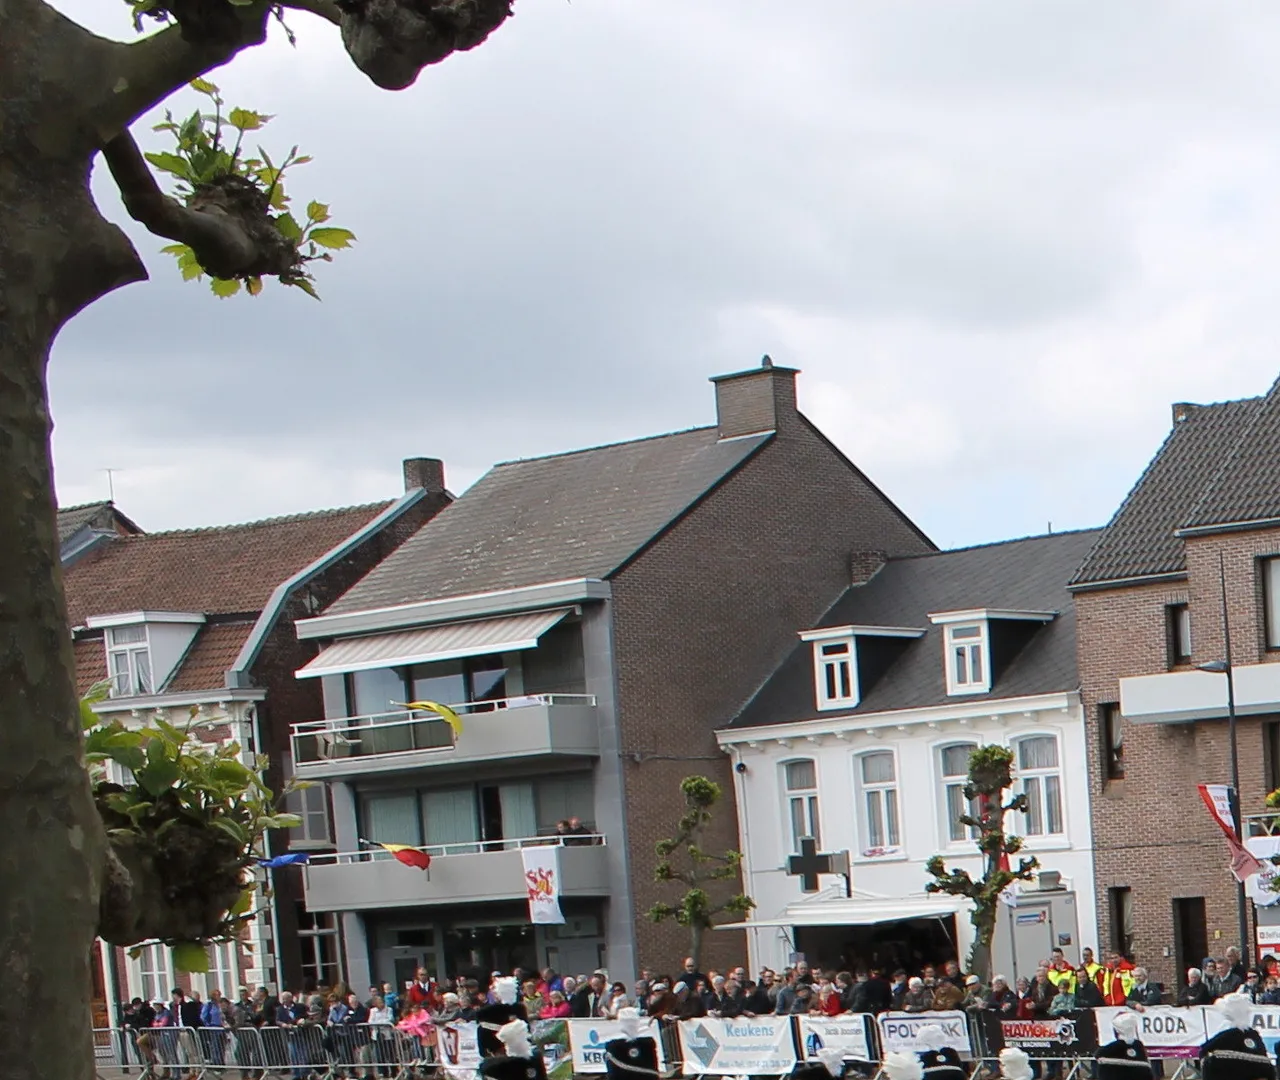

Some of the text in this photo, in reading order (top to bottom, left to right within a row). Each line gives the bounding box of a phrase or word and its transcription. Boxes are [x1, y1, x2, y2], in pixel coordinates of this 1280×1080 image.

[725, 1023, 775, 1038] Keukens
[1143, 1017, 1187, 1034] RODA
[584, 1052, 606, 1064] KB
